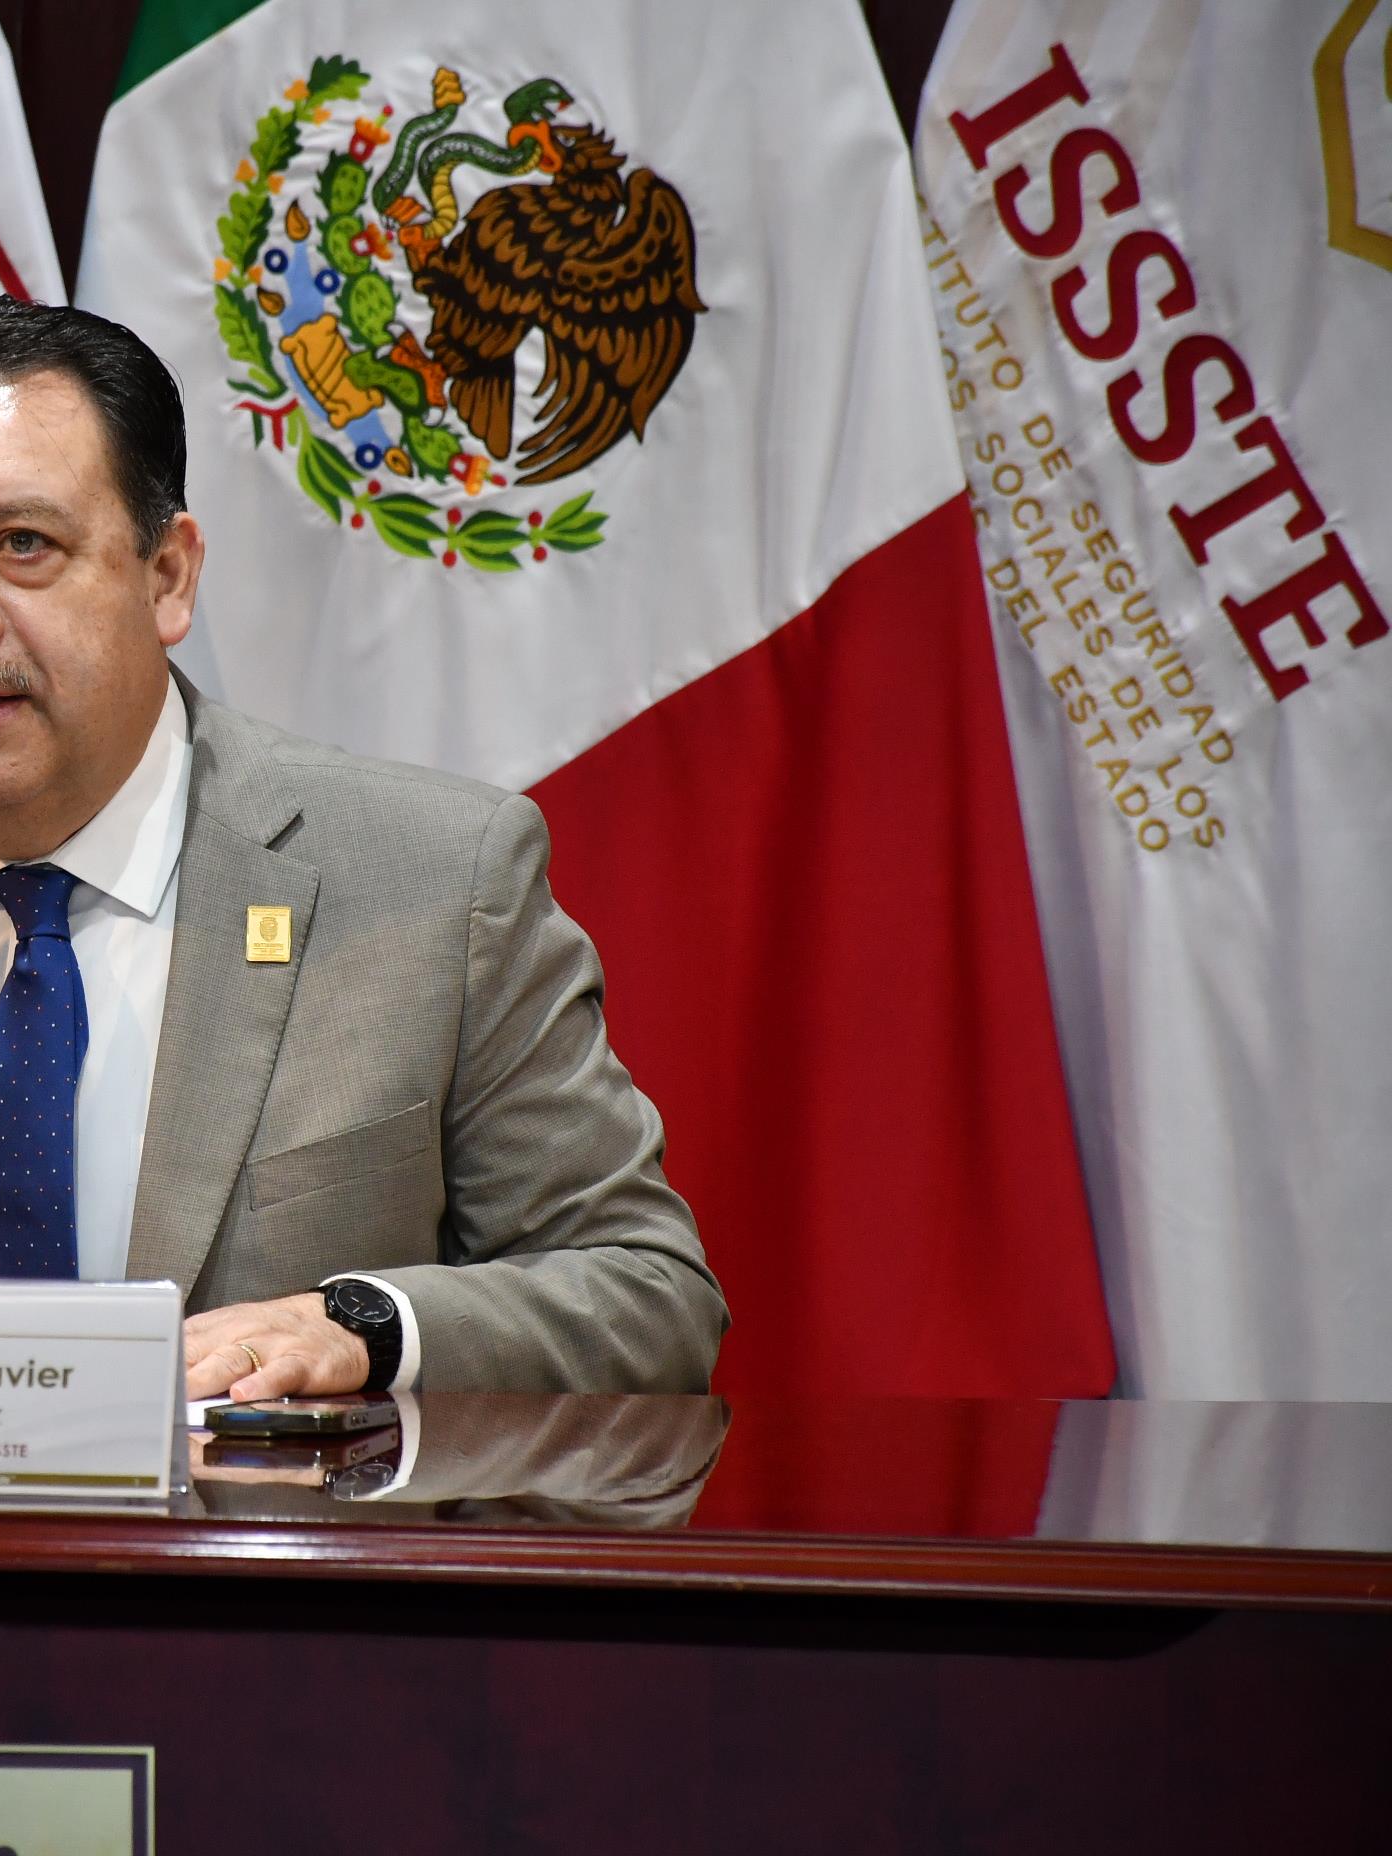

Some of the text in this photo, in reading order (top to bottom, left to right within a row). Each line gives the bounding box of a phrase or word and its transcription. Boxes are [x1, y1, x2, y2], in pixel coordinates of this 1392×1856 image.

[948, 41, 1391, 702] ISSSTE
[975, 432, 1114, 657] SOCIALES
[1110, 676, 1163, 740] DE
[1156, 756, 1226, 849] LOS
[986, 558, 1171, 853] DEL ESTADO
[1021, 413, 1073, 480] DE
[1070, 501, 1234, 765] SEGURIDAD
